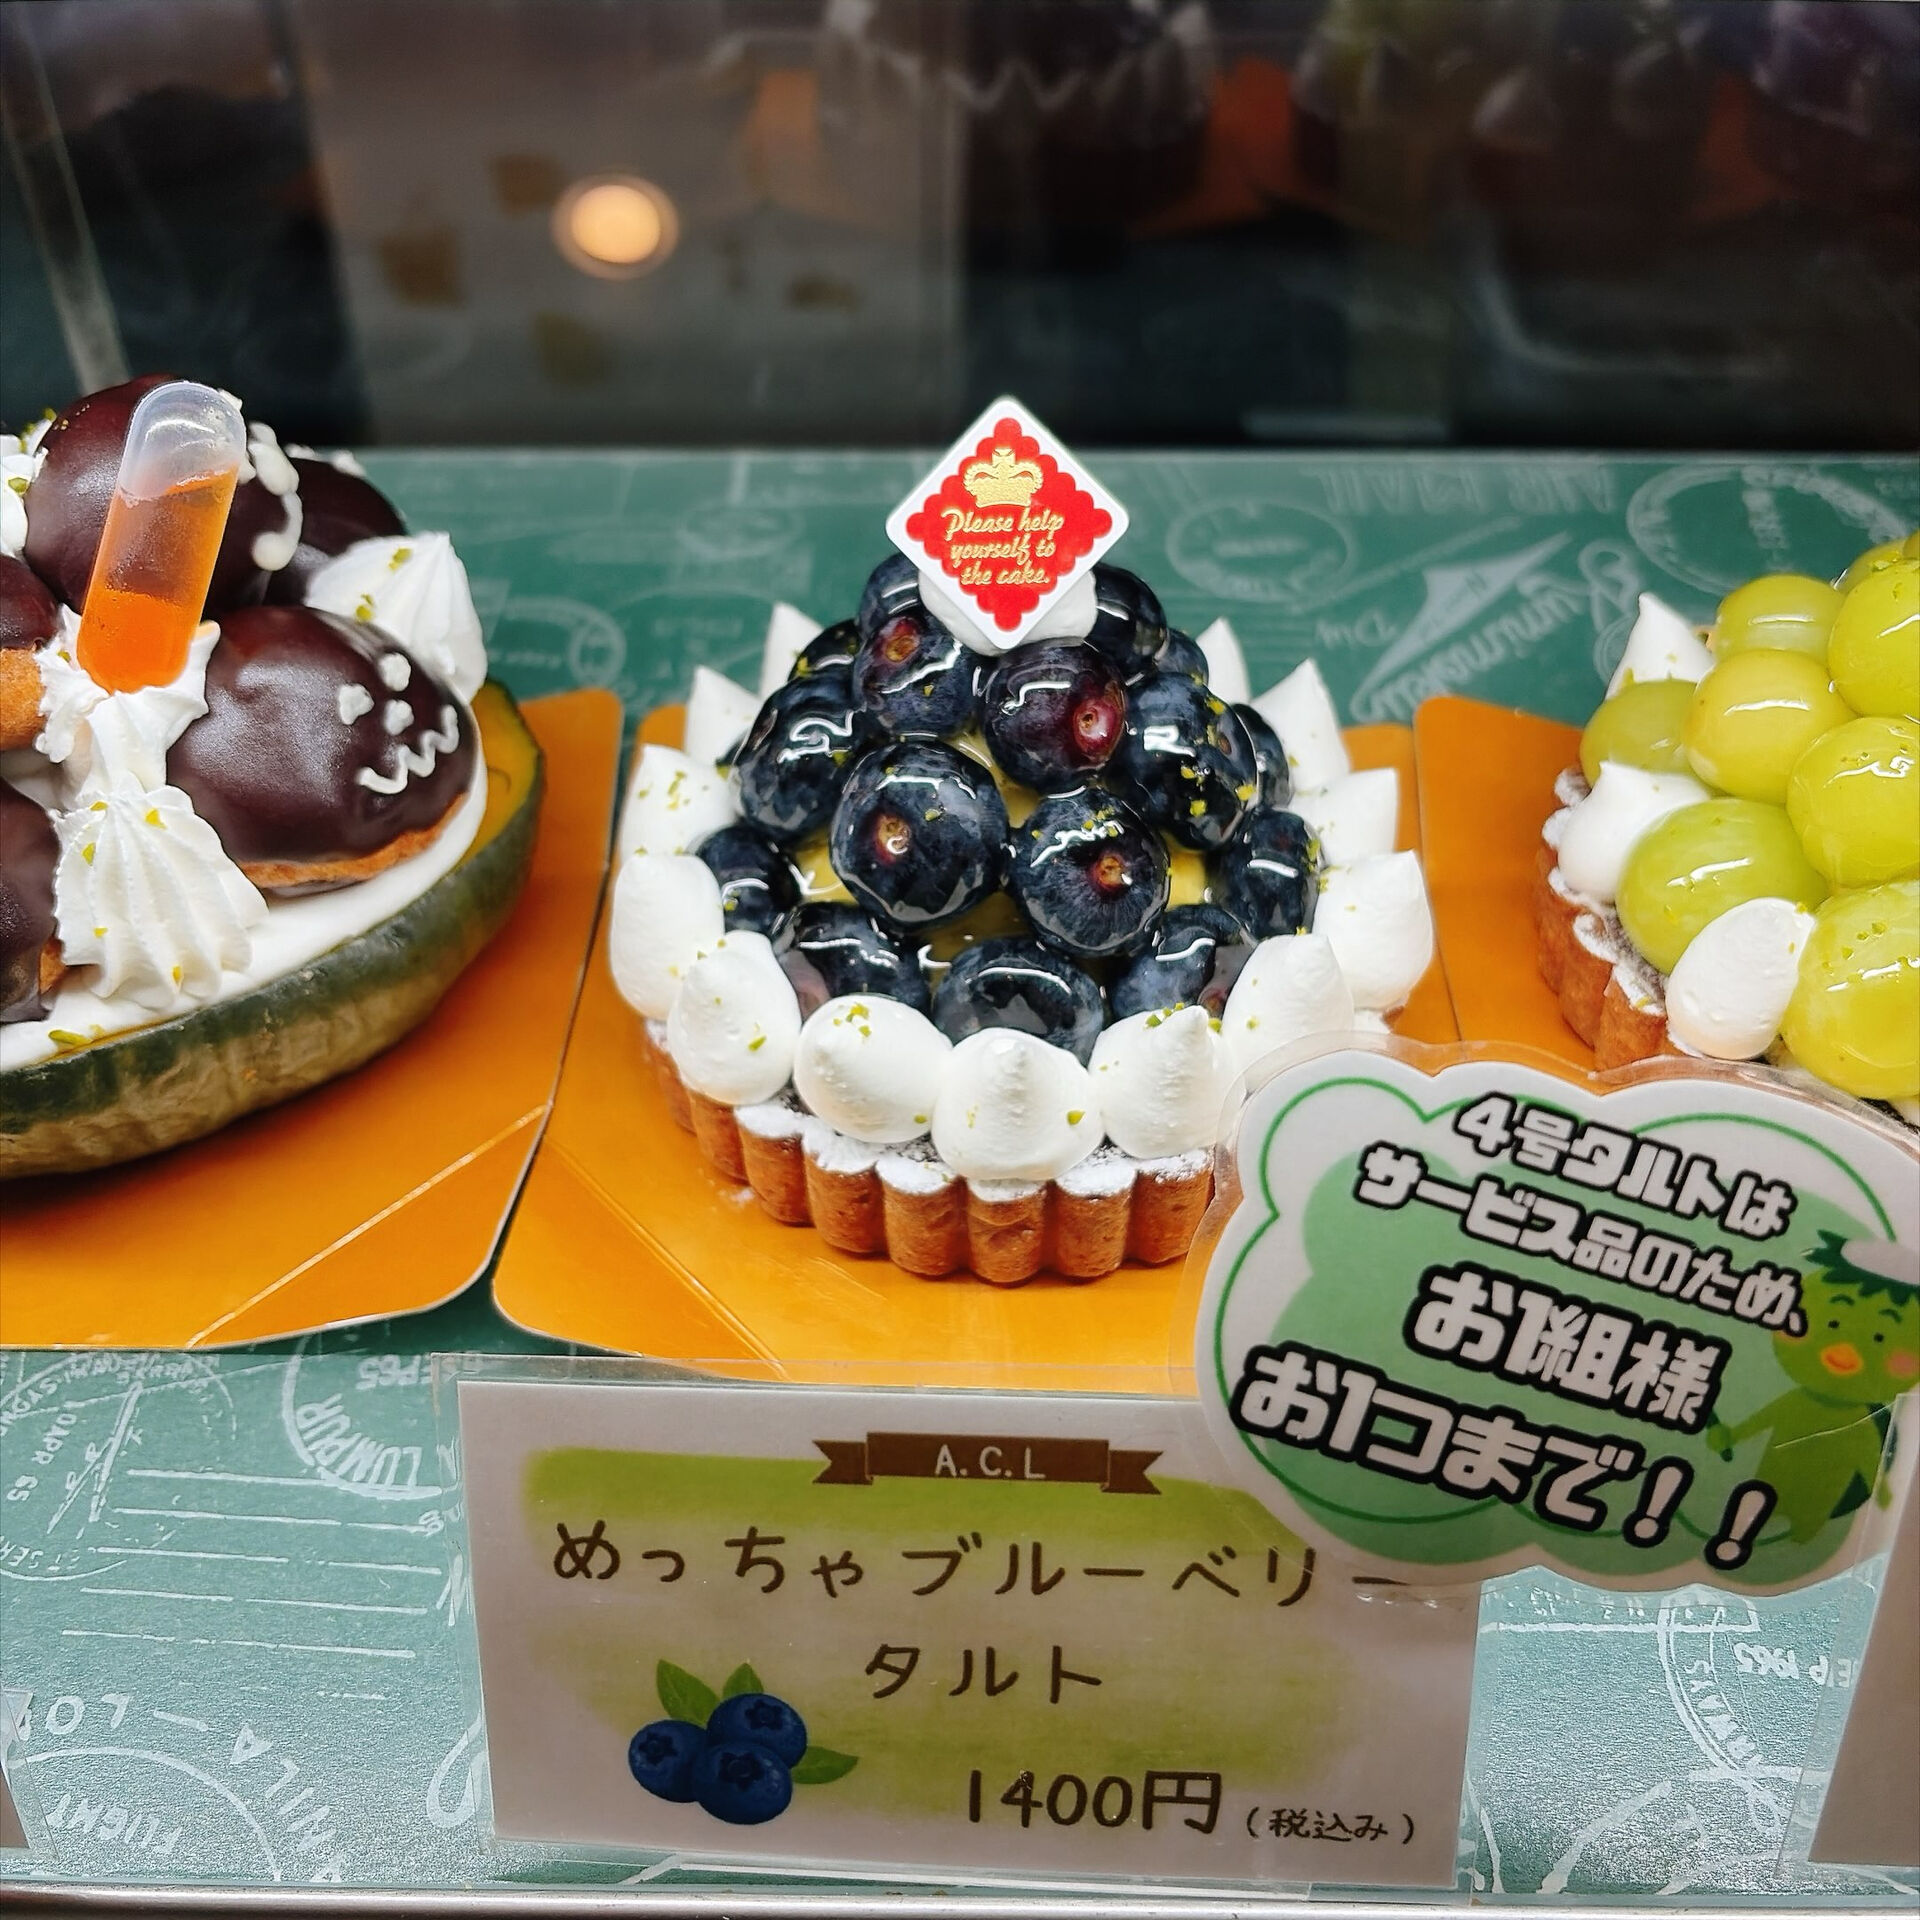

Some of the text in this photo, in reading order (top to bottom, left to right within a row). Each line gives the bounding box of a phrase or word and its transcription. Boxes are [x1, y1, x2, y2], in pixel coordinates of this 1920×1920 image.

[941, 507, 1065, 541] Please help
[950, 533, 1056, 568] yourself to
[961, 560, 1051, 586] the cake.
[1452, 1090, 1797, 1239] 4号タルトは
[1356, 1140, 1807, 1336] サービス品のため、
[1404, 1262, 1732, 1433] お1組様
[295, 1392, 423, 1489] LUMPUR
[935, 1446, 1044, 1479] A.C.L
[553, 1519, 1411, 1608] めっちゃブルーベリー
[864, 1644, 1103, 1705] タルト
[48, 1792, 181, 1853] FLIGHT
[966, 1769, 1222, 1835] 1400円
